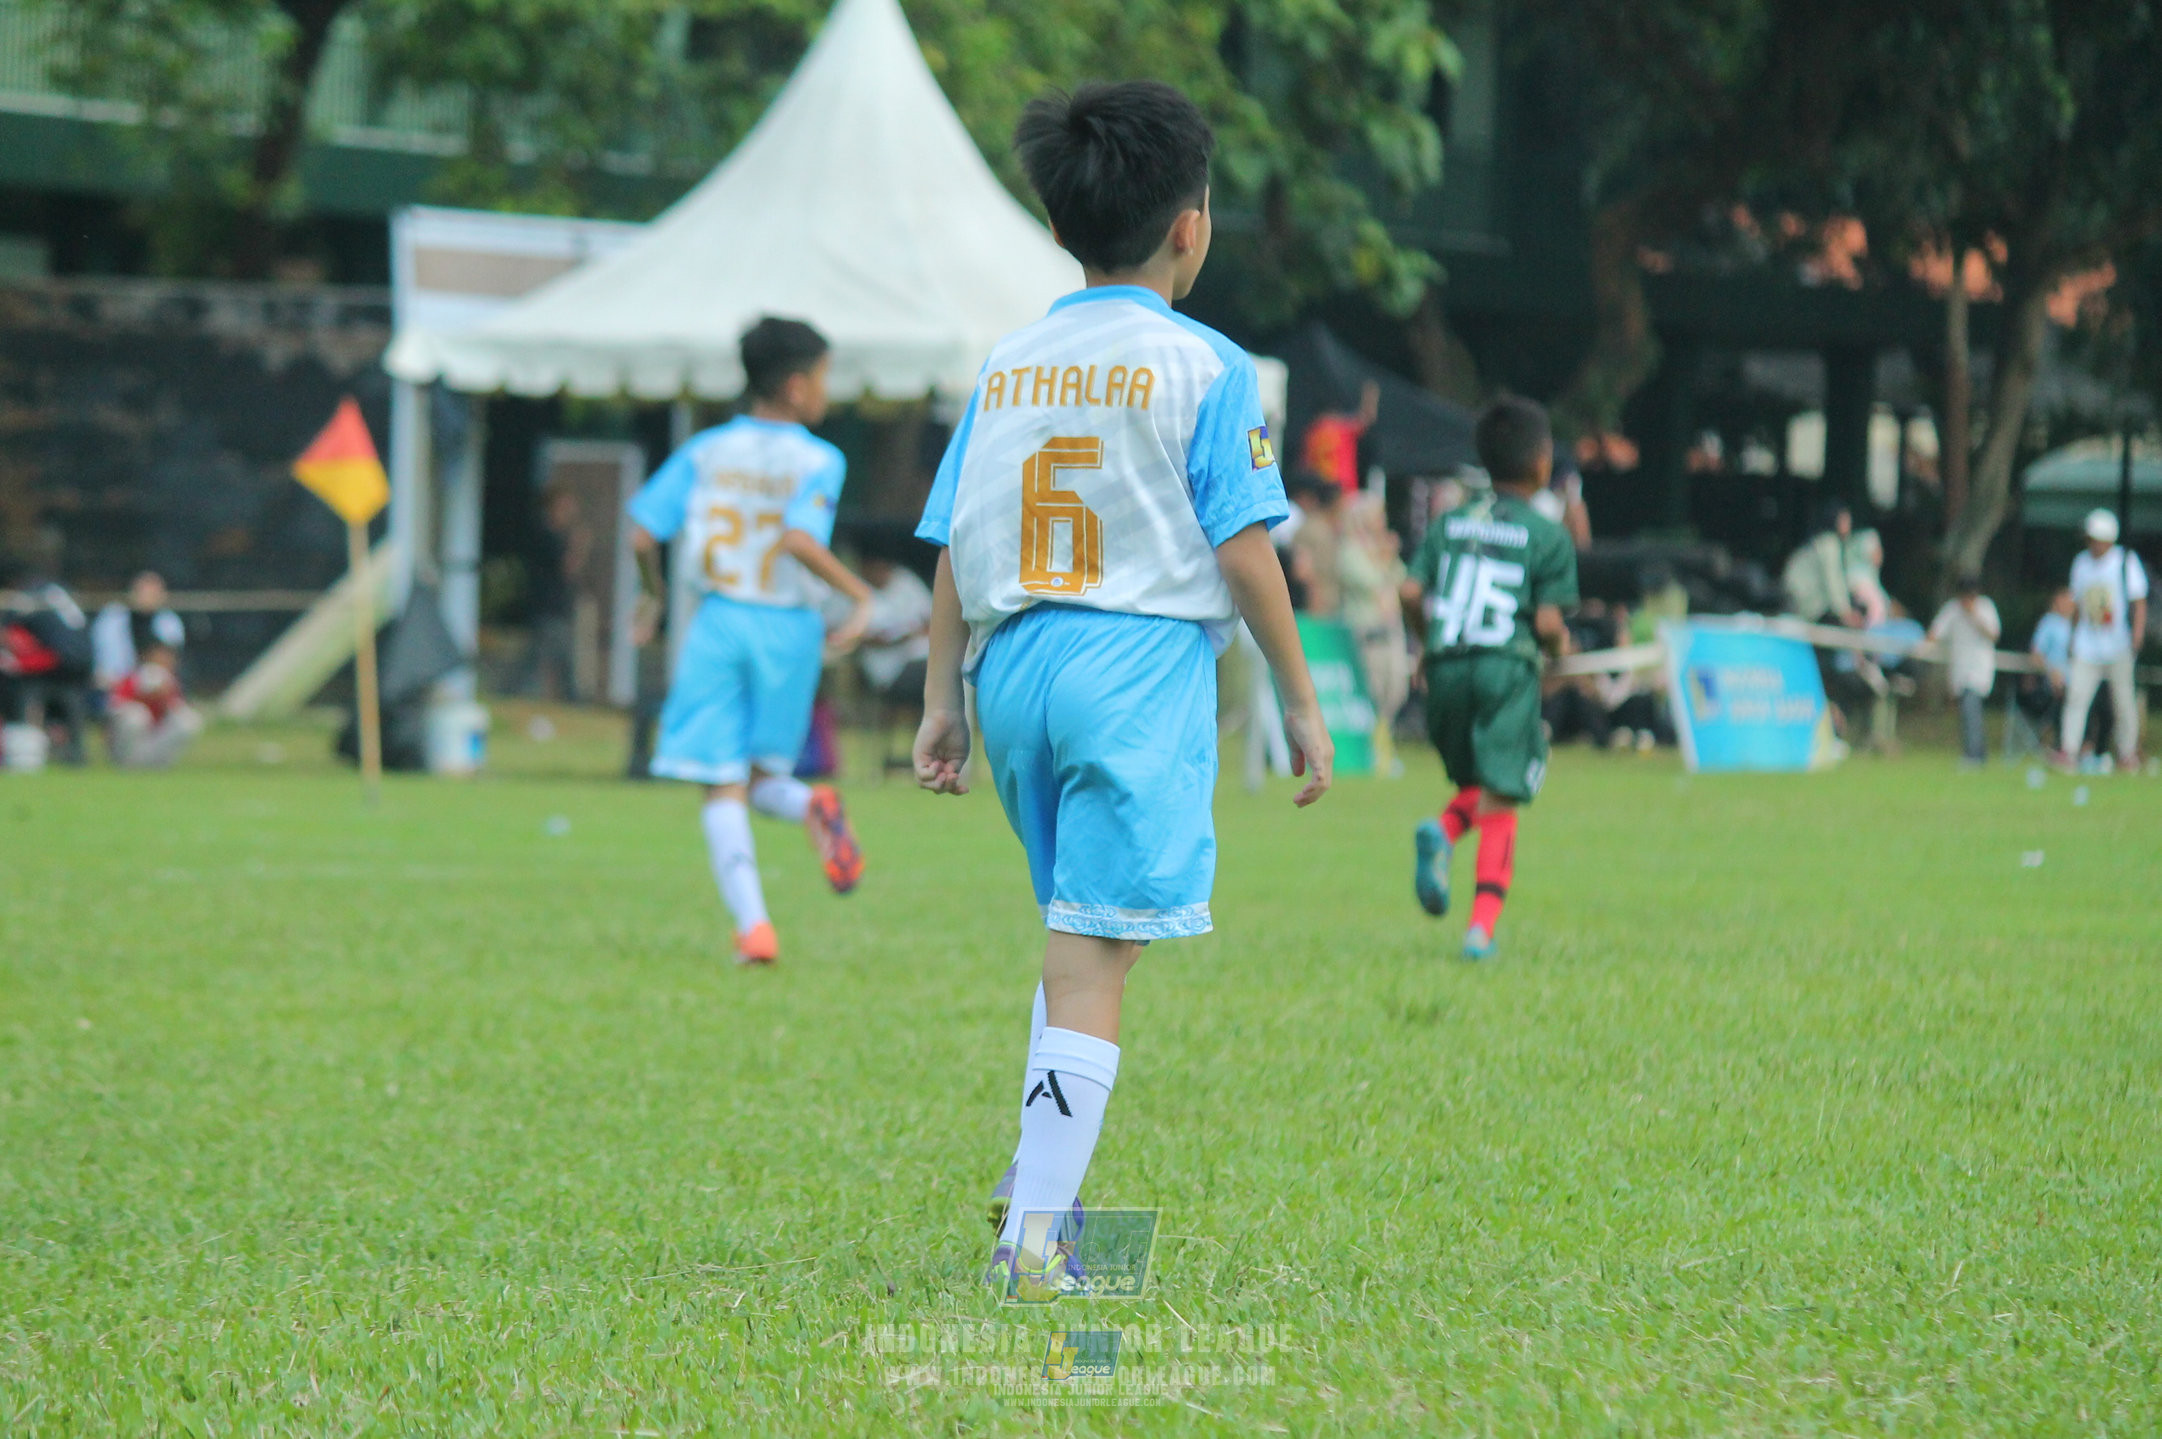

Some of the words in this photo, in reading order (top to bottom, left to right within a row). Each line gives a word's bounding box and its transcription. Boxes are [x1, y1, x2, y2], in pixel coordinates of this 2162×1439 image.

[983, 364, 1155, 412] ATHALAA
[704, 506, 783, 592] 27
[1019, 436, 1104, 596] 6
[1430, 556, 1526, 648] 46
